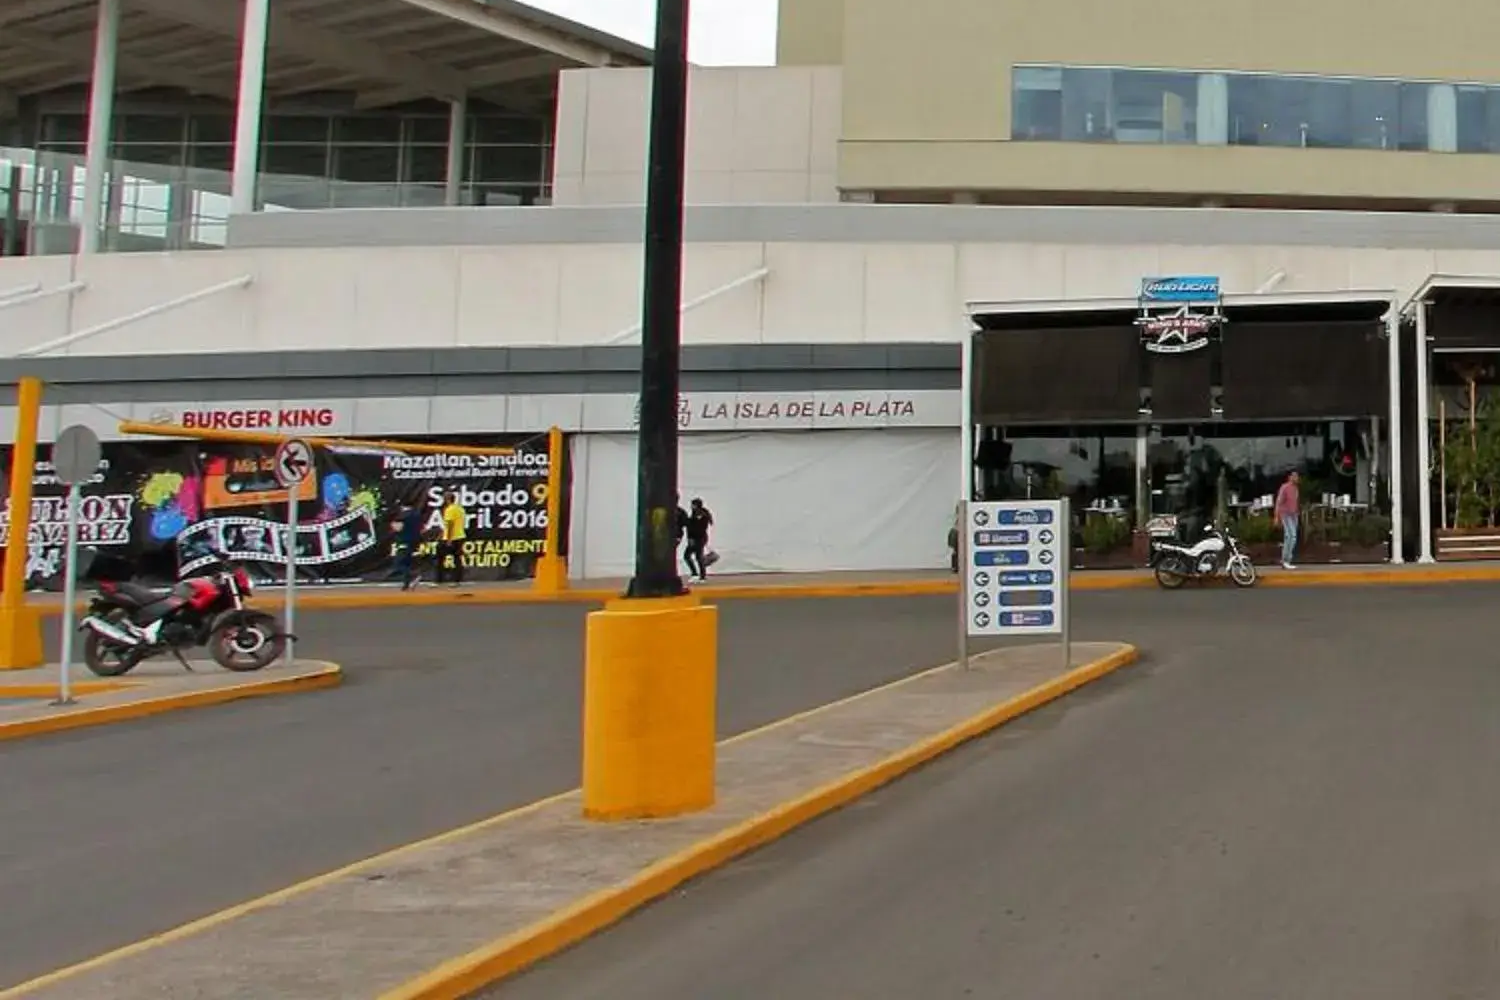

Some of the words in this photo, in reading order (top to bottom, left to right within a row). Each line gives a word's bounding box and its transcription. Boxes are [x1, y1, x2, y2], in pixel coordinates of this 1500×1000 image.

[182, 411, 271, 428] BURGER
[278, 409, 333, 426] KING
[701, 403, 728, 418] LA
[734, 403, 780, 418] ISLA
[786, 402, 814, 417] DE
[819, 401, 845, 417] LA
[851, 400, 914, 417] PLATA
[532, 484, 548, 504] 9
[424, 507, 493, 530] Aril
[499, 509, 549, 529] 2016
